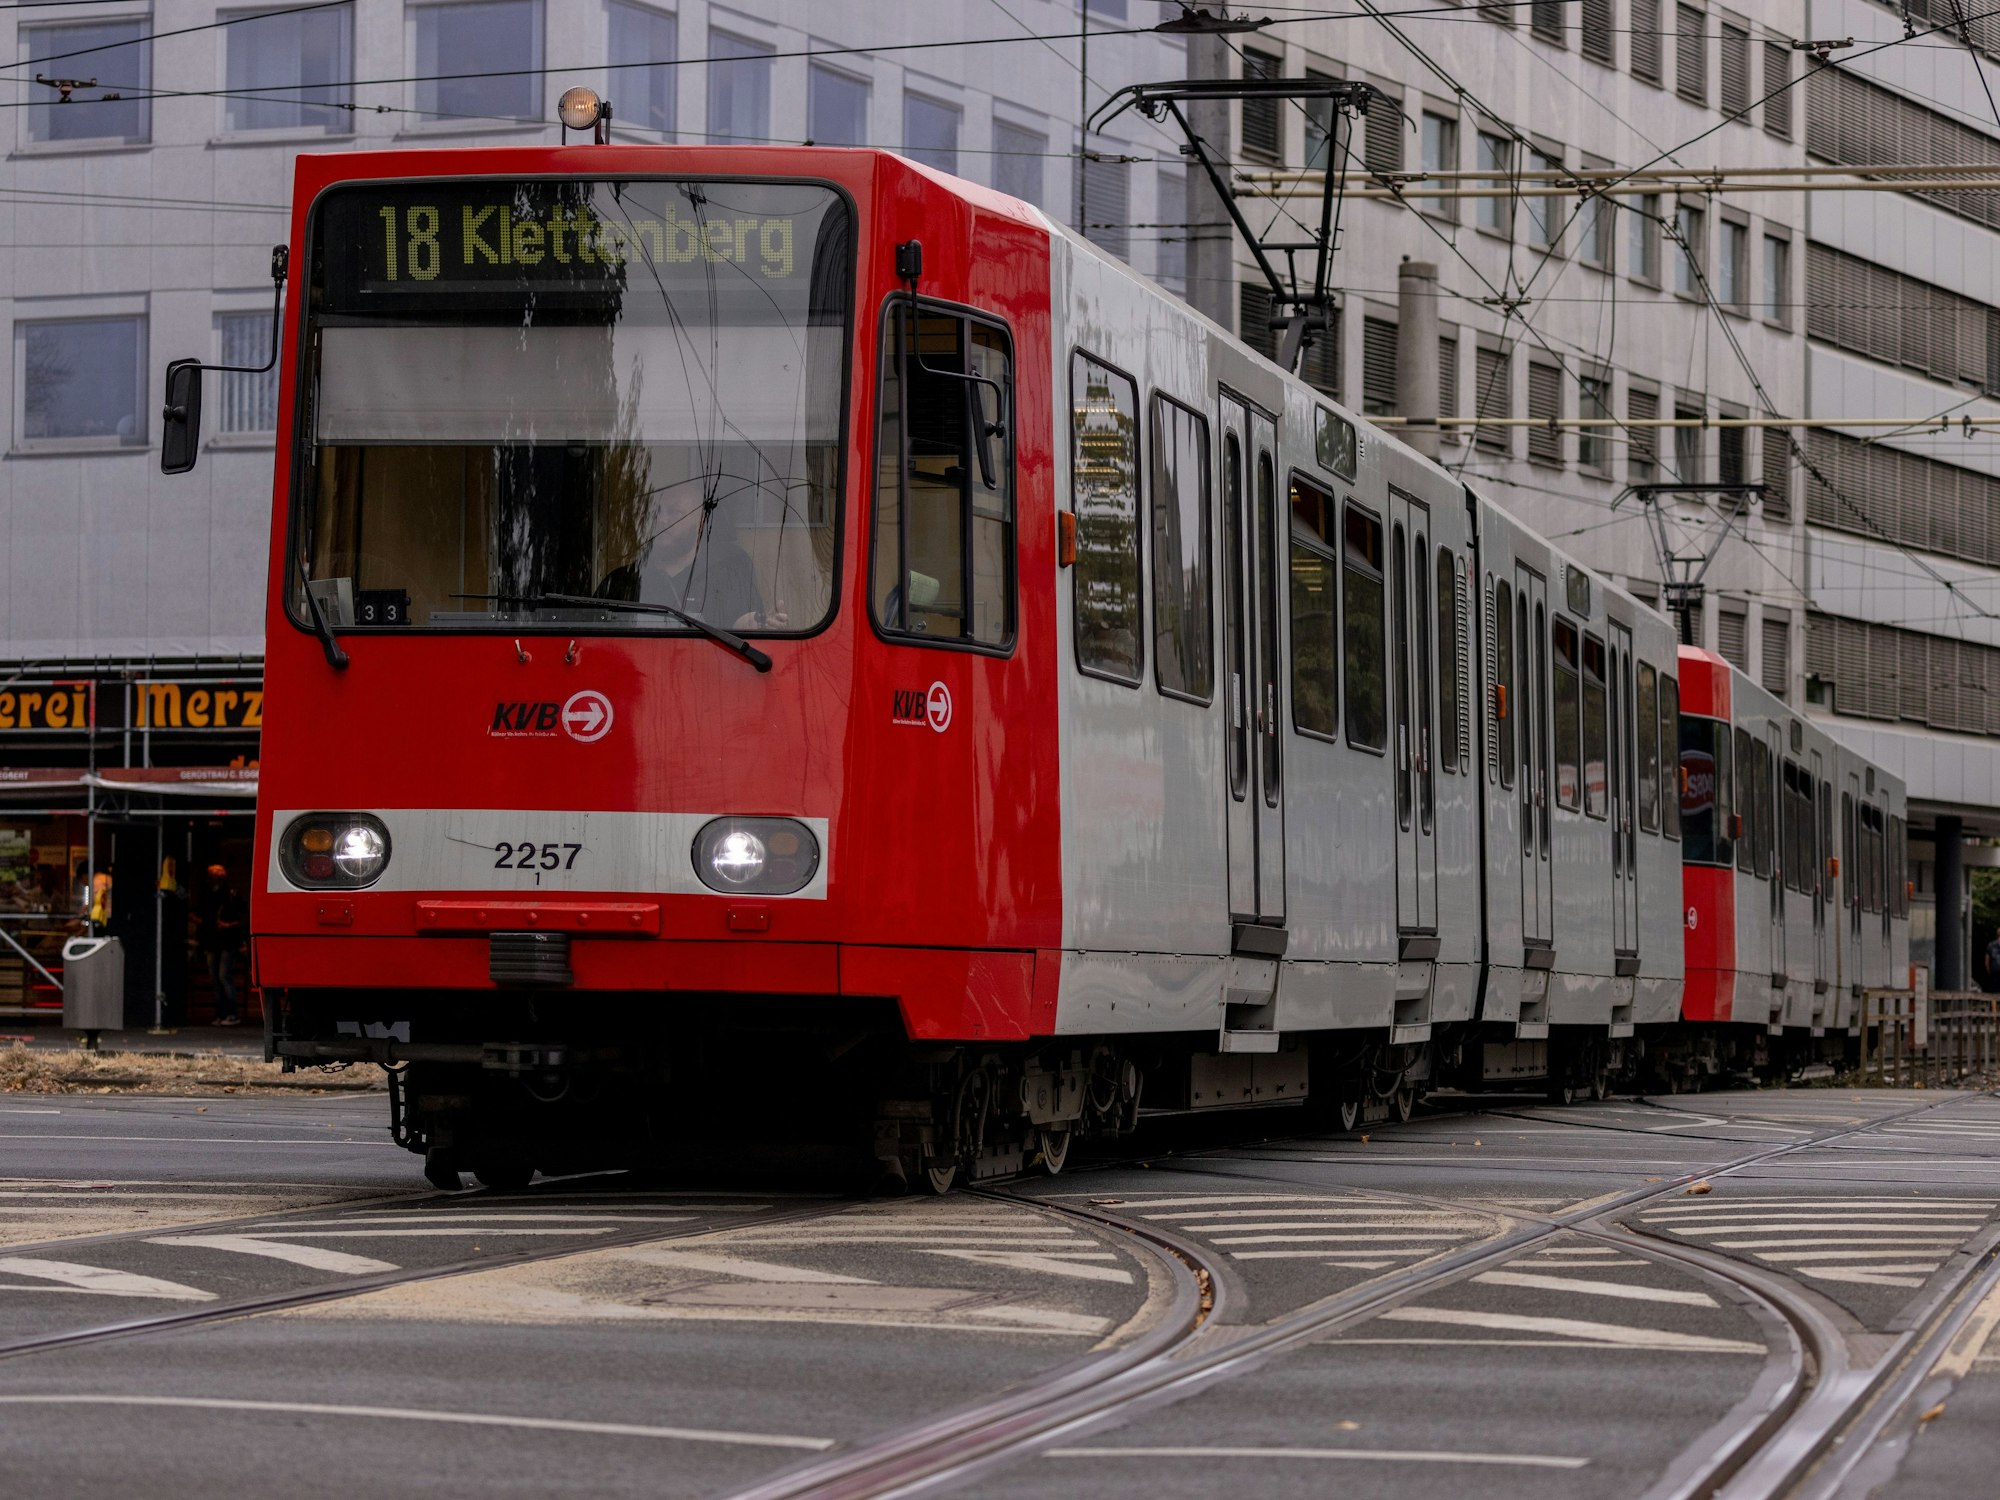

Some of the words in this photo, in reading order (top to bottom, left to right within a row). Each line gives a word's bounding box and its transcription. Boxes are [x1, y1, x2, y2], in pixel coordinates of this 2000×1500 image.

[379, 206, 440, 281] 18
[462, 201, 795, 279] Klettenberg
[0, 684, 87, 729] erei
[135, 683, 263, 728] Merz
[493, 703, 560, 730] KVB
[893, 689, 926, 718] KVB
[494, 842, 582, 870] 2257
[534, 872, 540, 886] 1
